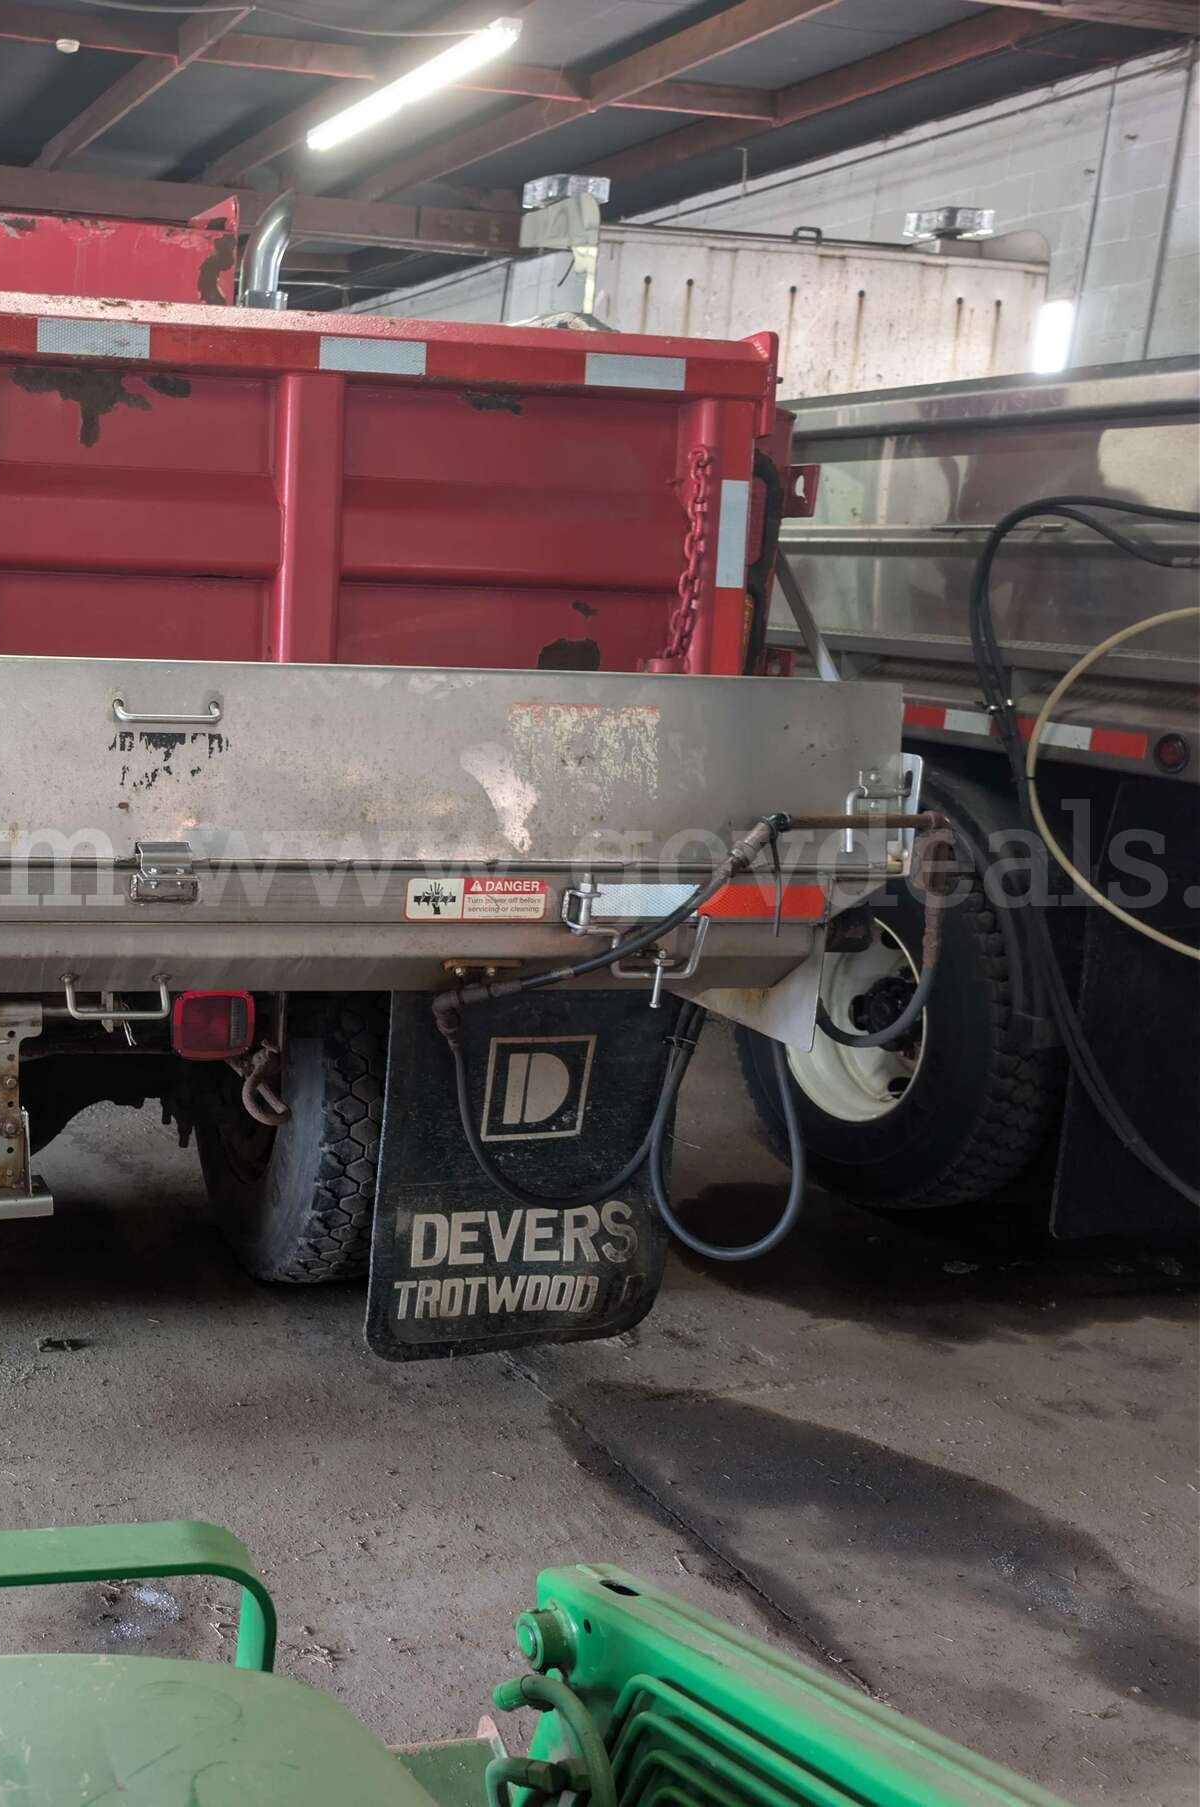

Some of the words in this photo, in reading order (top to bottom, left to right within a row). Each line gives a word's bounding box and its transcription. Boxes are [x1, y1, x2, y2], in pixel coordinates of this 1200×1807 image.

[485, 880, 540, 892] DANGER
[467, 896, 483, 904] Turn
[519, 896, 541, 904] before
[468, 905, 500, 913] servicing
[510, 905, 541, 913] cleaning
[410, 1201, 639, 1268] DEVERS
[394, 1274, 600, 1320] TROTWOOD
